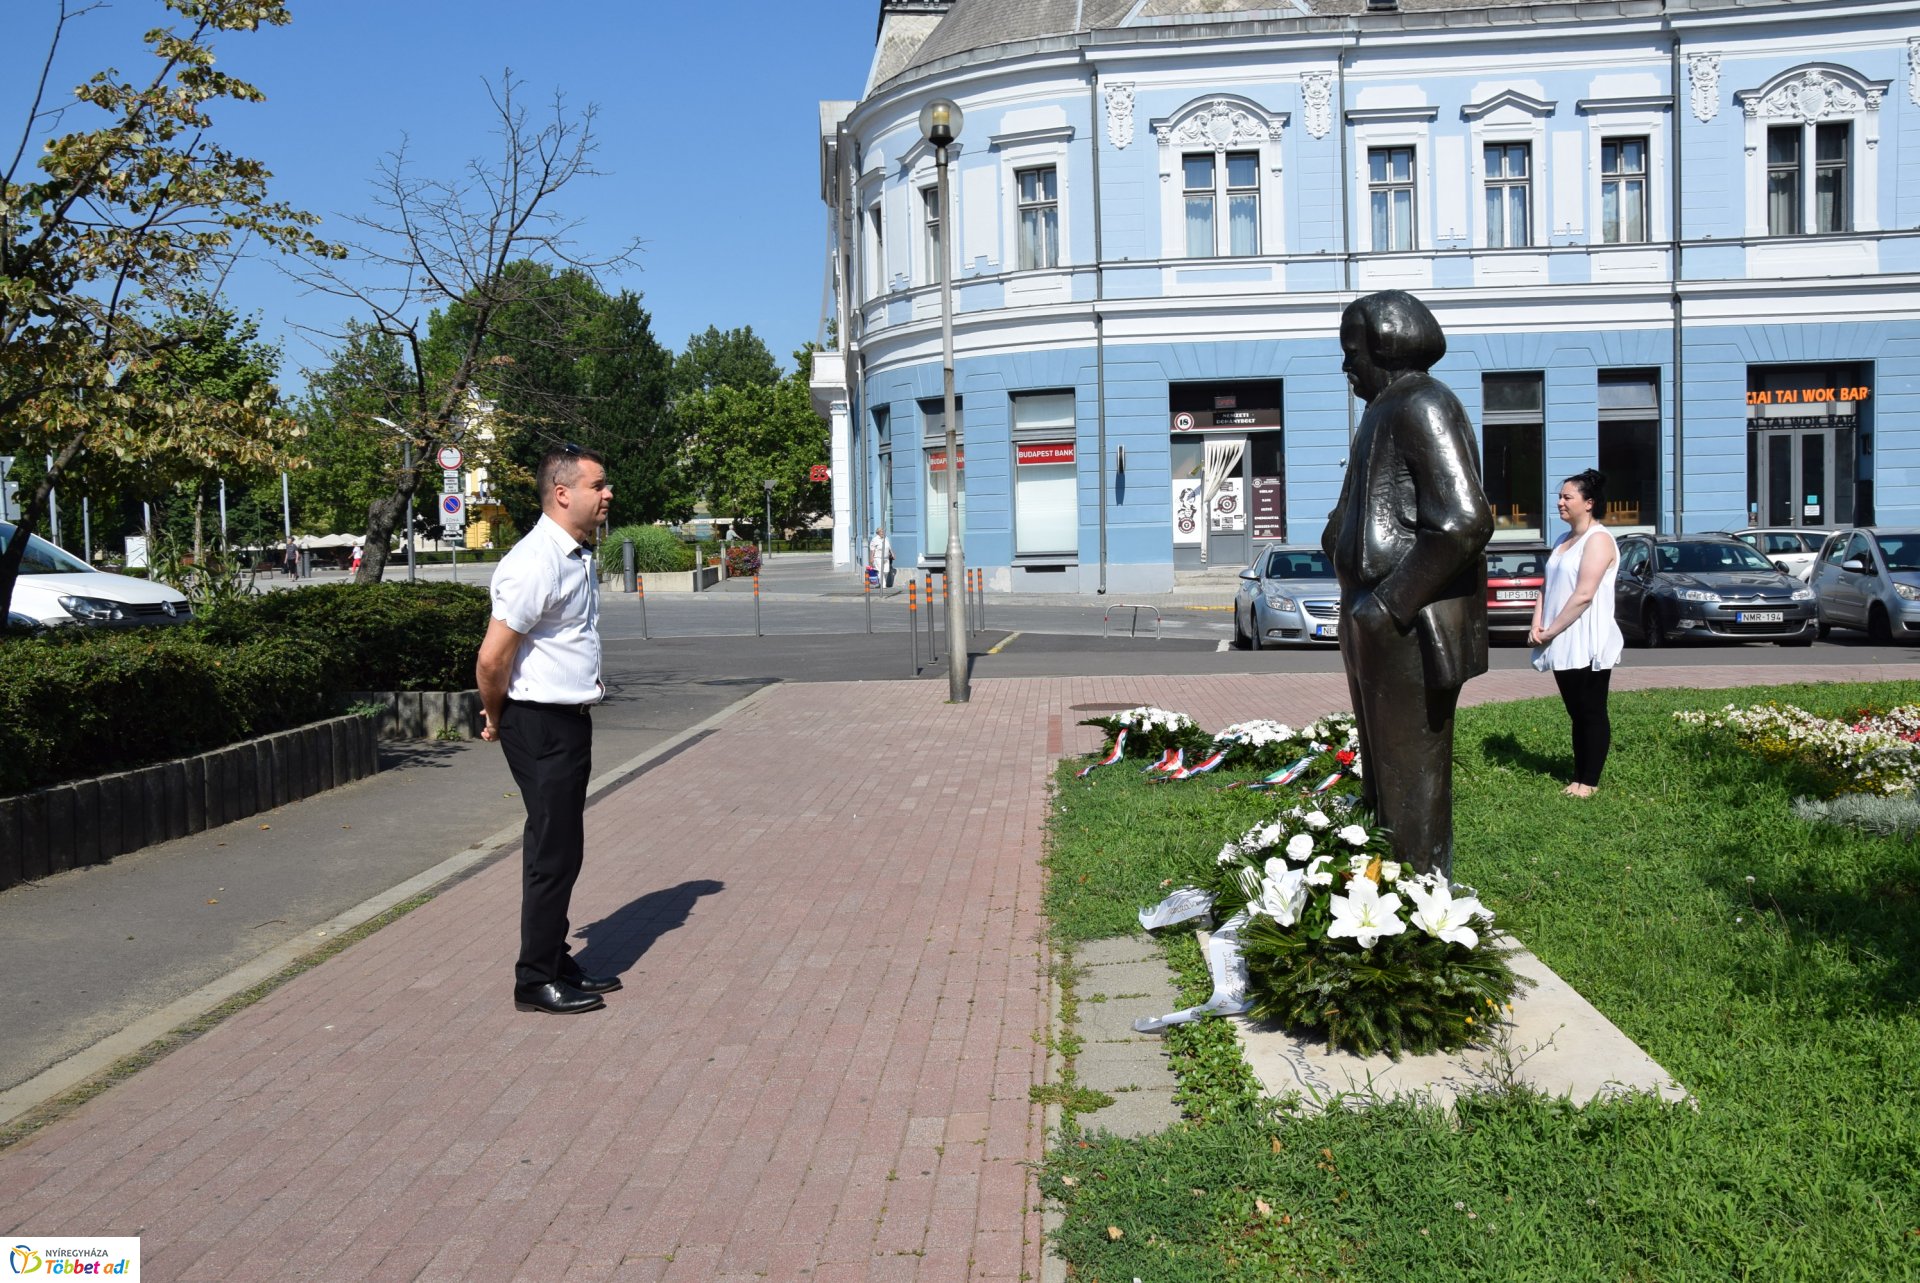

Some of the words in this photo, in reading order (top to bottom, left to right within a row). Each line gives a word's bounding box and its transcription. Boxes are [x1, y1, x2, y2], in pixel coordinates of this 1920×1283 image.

[1775, 390, 1797, 403] TAI
[1802, 389, 1835, 402] WOK
[1840, 387, 1868, 400] BAR
[1018, 450, 1053, 458] BUDAPEST
